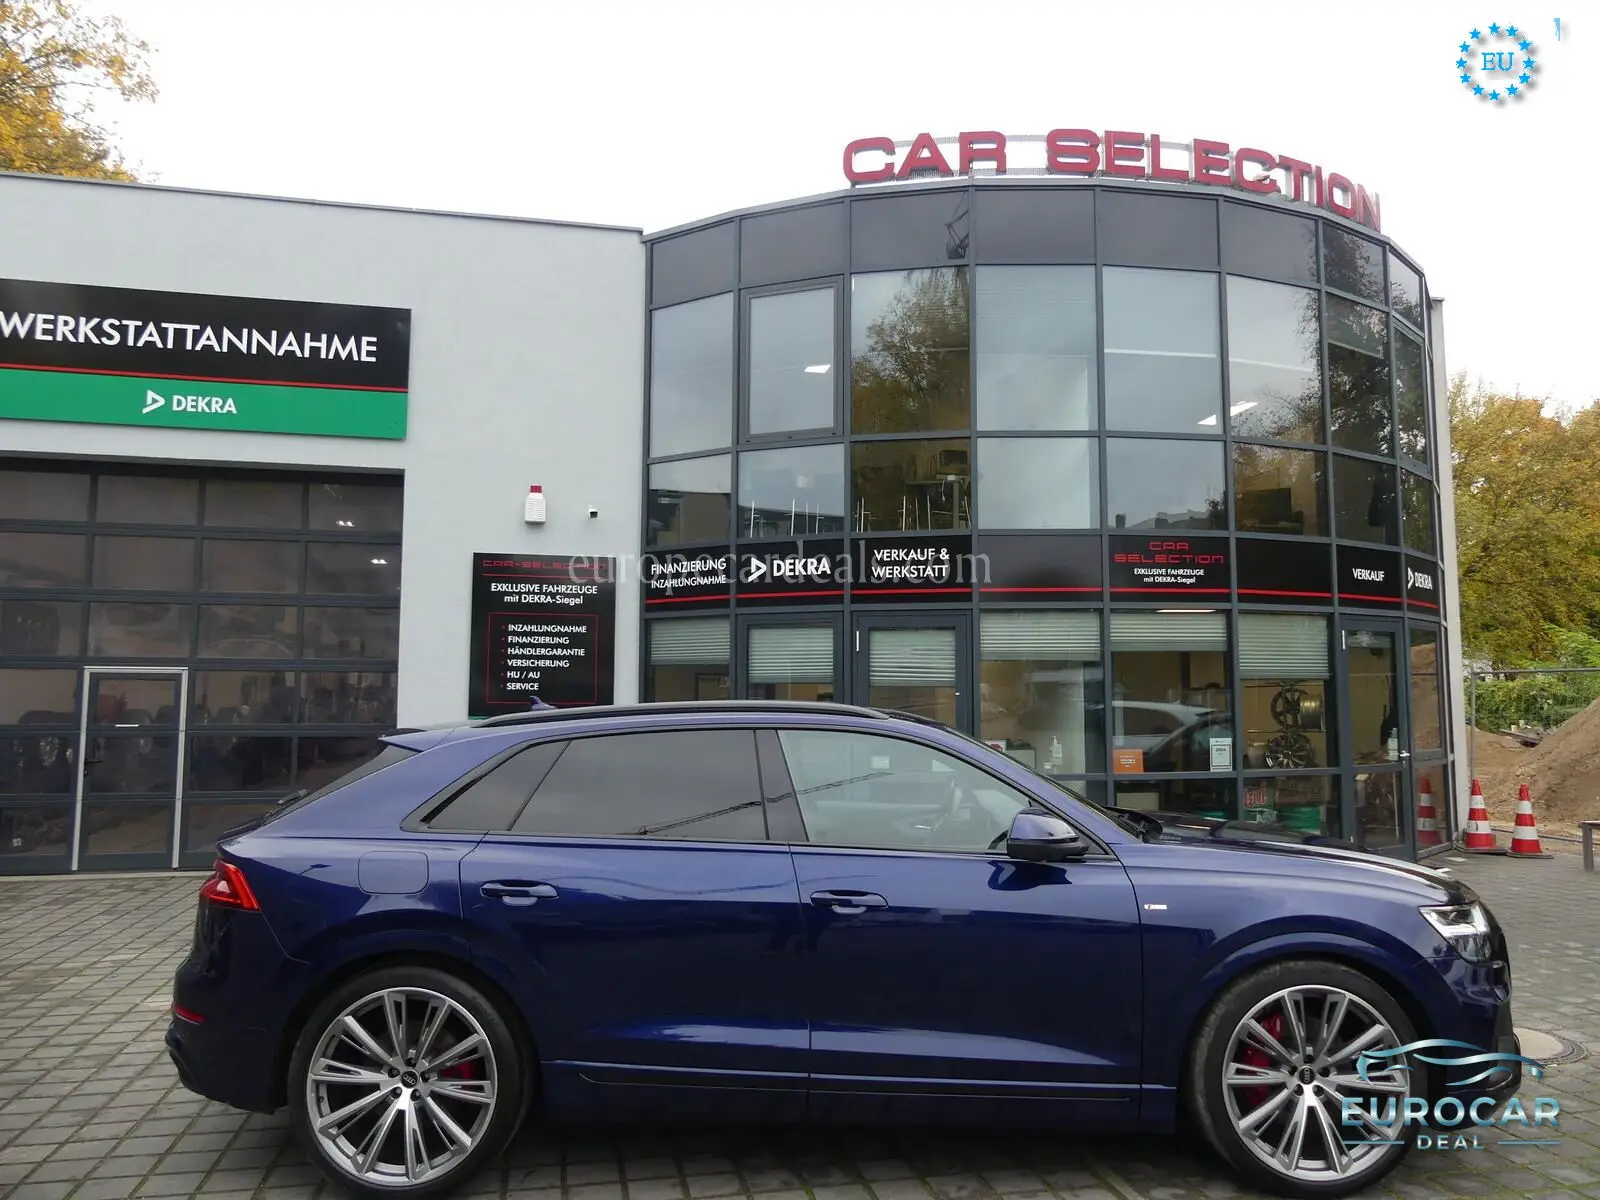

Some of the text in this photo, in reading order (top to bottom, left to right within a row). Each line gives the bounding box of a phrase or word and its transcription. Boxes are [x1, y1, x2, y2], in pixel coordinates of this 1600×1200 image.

[842, 128, 1381, 232] CAR SELECTION
[0, 311, 378, 363] WERKSTATTANNAHME
[172, 395, 237, 415] DEKRA
[1149, 541, 1189, 551] CAR
[874, 548, 950, 562] VERKAUF &
[1114, 553, 1224, 564] SELECTION
[651, 558, 727, 576] FINANZIERUNG
[773, 557, 831, 577] DEKRA
[872, 565, 949, 579] WERKSTATT
[1133, 568, 1205, 576] EXKLUSIVE FAHRZEUGE
[1352, 568, 1385, 582] VERKAUF
[1414, 572, 1433, 590] DEKRA
[651, 575, 726, 589] INZAHLUNGNAHME
[490, 583, 598, 594] EXKLUSIVE FAHRZEUGE
[504, 594, 583, 606] mit DEKRA-Siegel
[508, 624, 587, 633] INZAHLUNGNAHME
[508, 636, 570, 645] FINANZIERUNG
[507, 646, 585, 656] HÄNDLERGARANTIE
[507, 659, 570, 668] VERSICHERUNG
[507, 671, 520, 679] HU
[528, 671, 540, 679] AU
[506, 682, 539, 691] SERVICE
